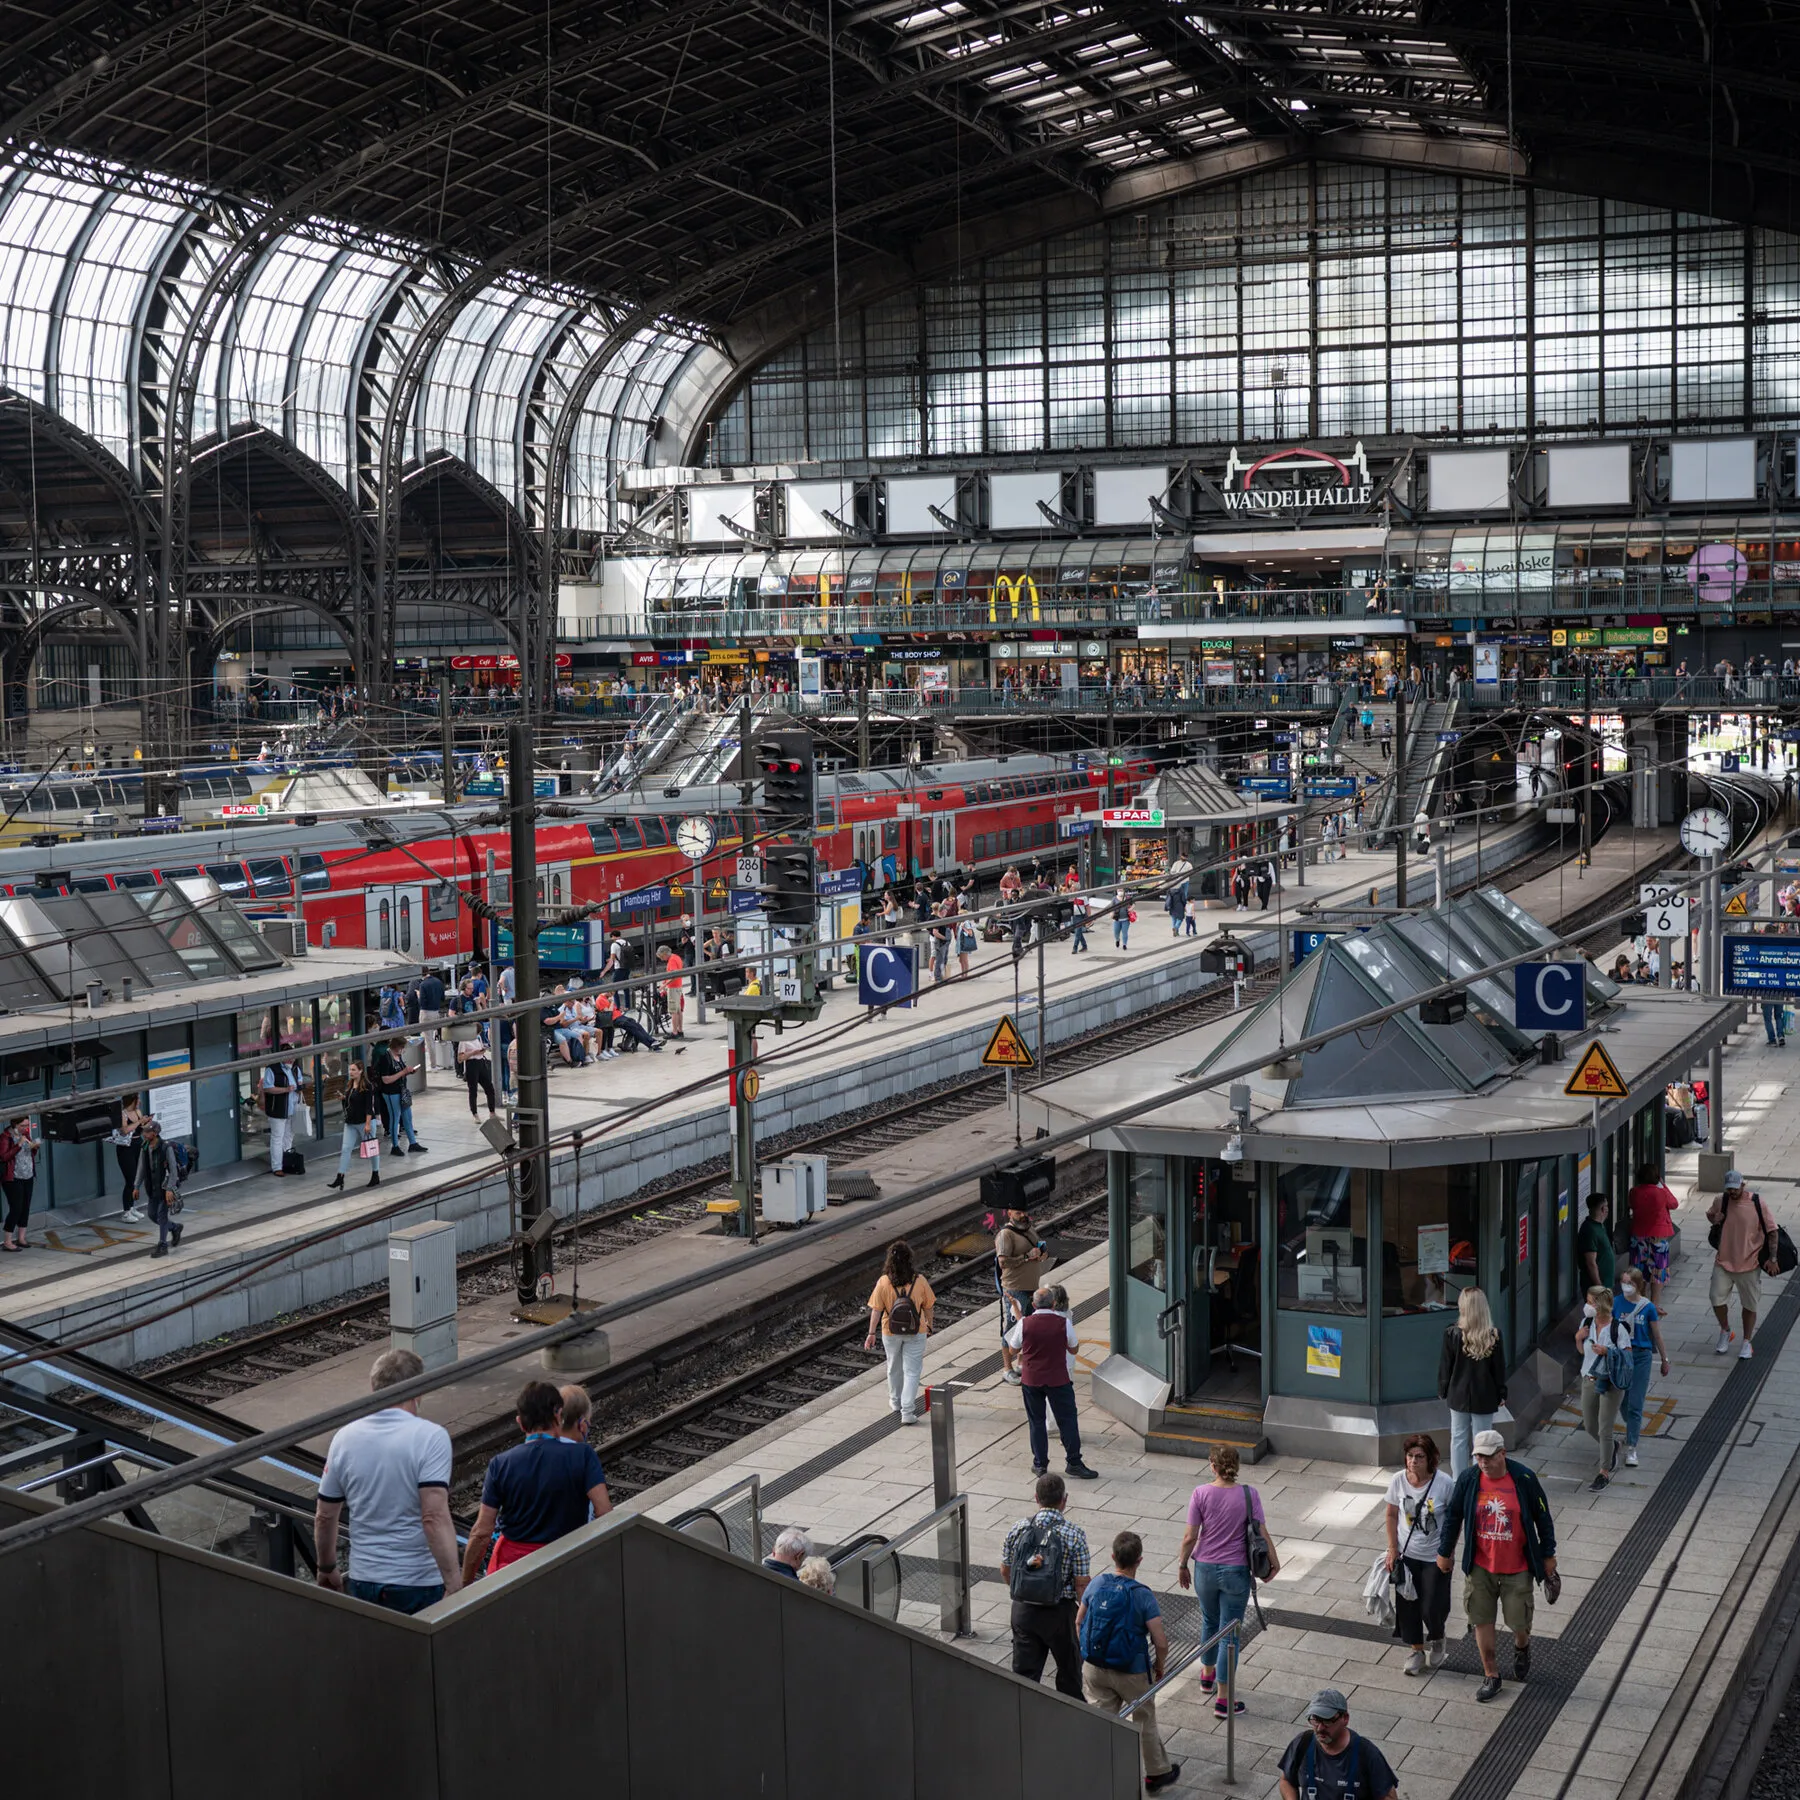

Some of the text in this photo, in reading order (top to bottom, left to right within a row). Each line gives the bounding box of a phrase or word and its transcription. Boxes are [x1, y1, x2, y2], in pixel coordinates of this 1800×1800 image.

[1223, 487, 1372, 510] WANDELHALLE
[1606, 631, 1650, 642] bierbar
[639, 655, 654, 663] AVIS
[904, 651, 923, 659] BODY
[923, 650, 941, 658] SHOP
[1277, 757, 1286, 771] E
[229, 806, 257, 814] SPAR
[1113, 811, 1149, 820] SPAR
[738, 858, 759, 871] 286
[745, 872, 753, 883] 6
[624, 890, 661, 907] Hamburg Hbf
[1657, 910, 1671, 931] 6
[571, 928, 579, 940] 7
[1310, 934, 1318, 948] 6
[865, 947, 895, 994] C
[784, 983, 796, 996] R7
[1535, 964, 1573, 1016] C
